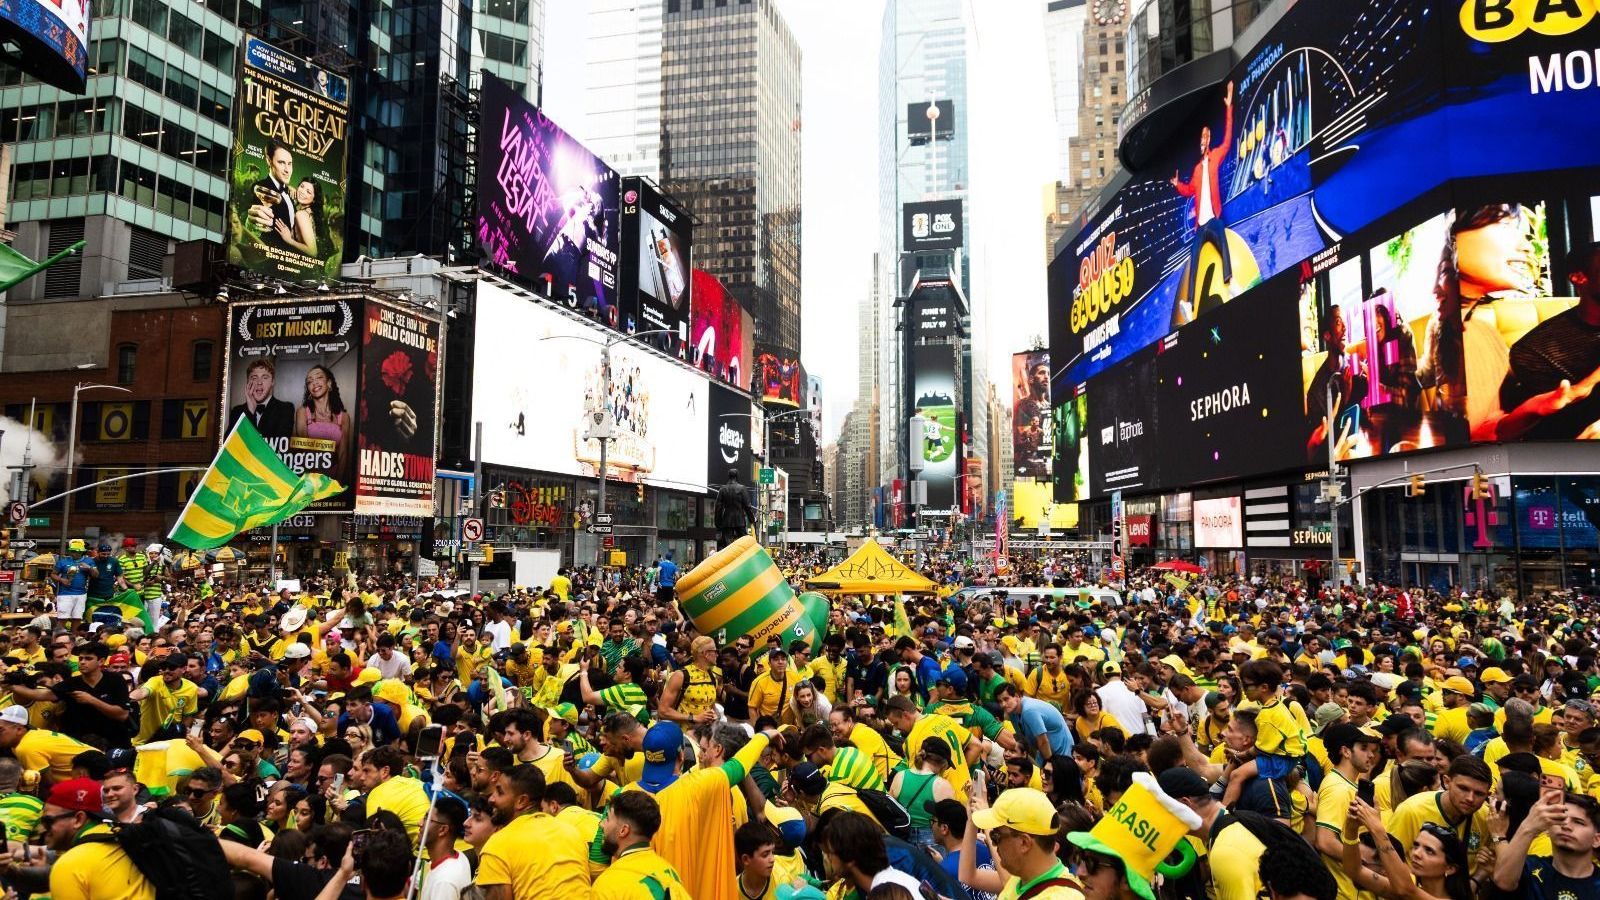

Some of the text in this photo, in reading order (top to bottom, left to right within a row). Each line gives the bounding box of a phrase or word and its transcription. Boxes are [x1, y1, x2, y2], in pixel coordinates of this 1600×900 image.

[252, 48, 297, 73] CORBIN BLEU
[270, 51, 295, 66] STARRING
[1239, 42, 1283, 95] JAY PHAROAH
[272, 65, 286, 74] NICK
[1529, 48, 1600, 95] MO
[244, 67, 347, 115] THE PARTY'S ROARING ON BROADWAY
[246, 81, 347, 140] THE GREAT
[255, 111, 334, 157] GATSBY
[625, 206, 636, 214] LG
[271, 246, 300, 260] BROADWAY
[301, 255, 325, 267] THEATRE
[587, 238, 610, 263] SUNDAYS
[1079, 231, 1116, 291] QUIZ
[1115, 241, 1131, 263] WITH
[1312, 243, 1341, 264] MARRIOTT
[285, 257, 315, 269] BROADWAY
[1313, 254, 1339, 274] MARQUIS
[256, 309, 262, 318] 8
[263, 308, 277, 317] TONY
[298, 304, 336, 315] NOMINATIONS
[256, 319, 334, 338] BEST MUSICAL
[380, 309, 428, 335] COME SEE HOW THE
[921, 321, 937, 329] JULY
[369, 318, 436, 353] WORLD COULD BE
[1190, 382, 1251, 422] SEPHORA
[264, 436, 289, 453] wo
[720, 422, 745, 449] alexa+
[276, 451, 332, 475] ngers
[360, 448, 432, 482] HADESTOWN
[360, 477, 390, 486] BROADWAY'S
[391, 479, 408, 488] GLOBAL
[408, 481, 432, 490] SENSATION
[1304, 470, 1329, 481] SEPHORA
[353, 512, 424, 527] GIFTS LUGGAGE
[1201, 516, 1233, 528] PANDORA
[1293, 530, 1333, 544] SEPHOR
[1109, 802, 1160, 852] RASIL
